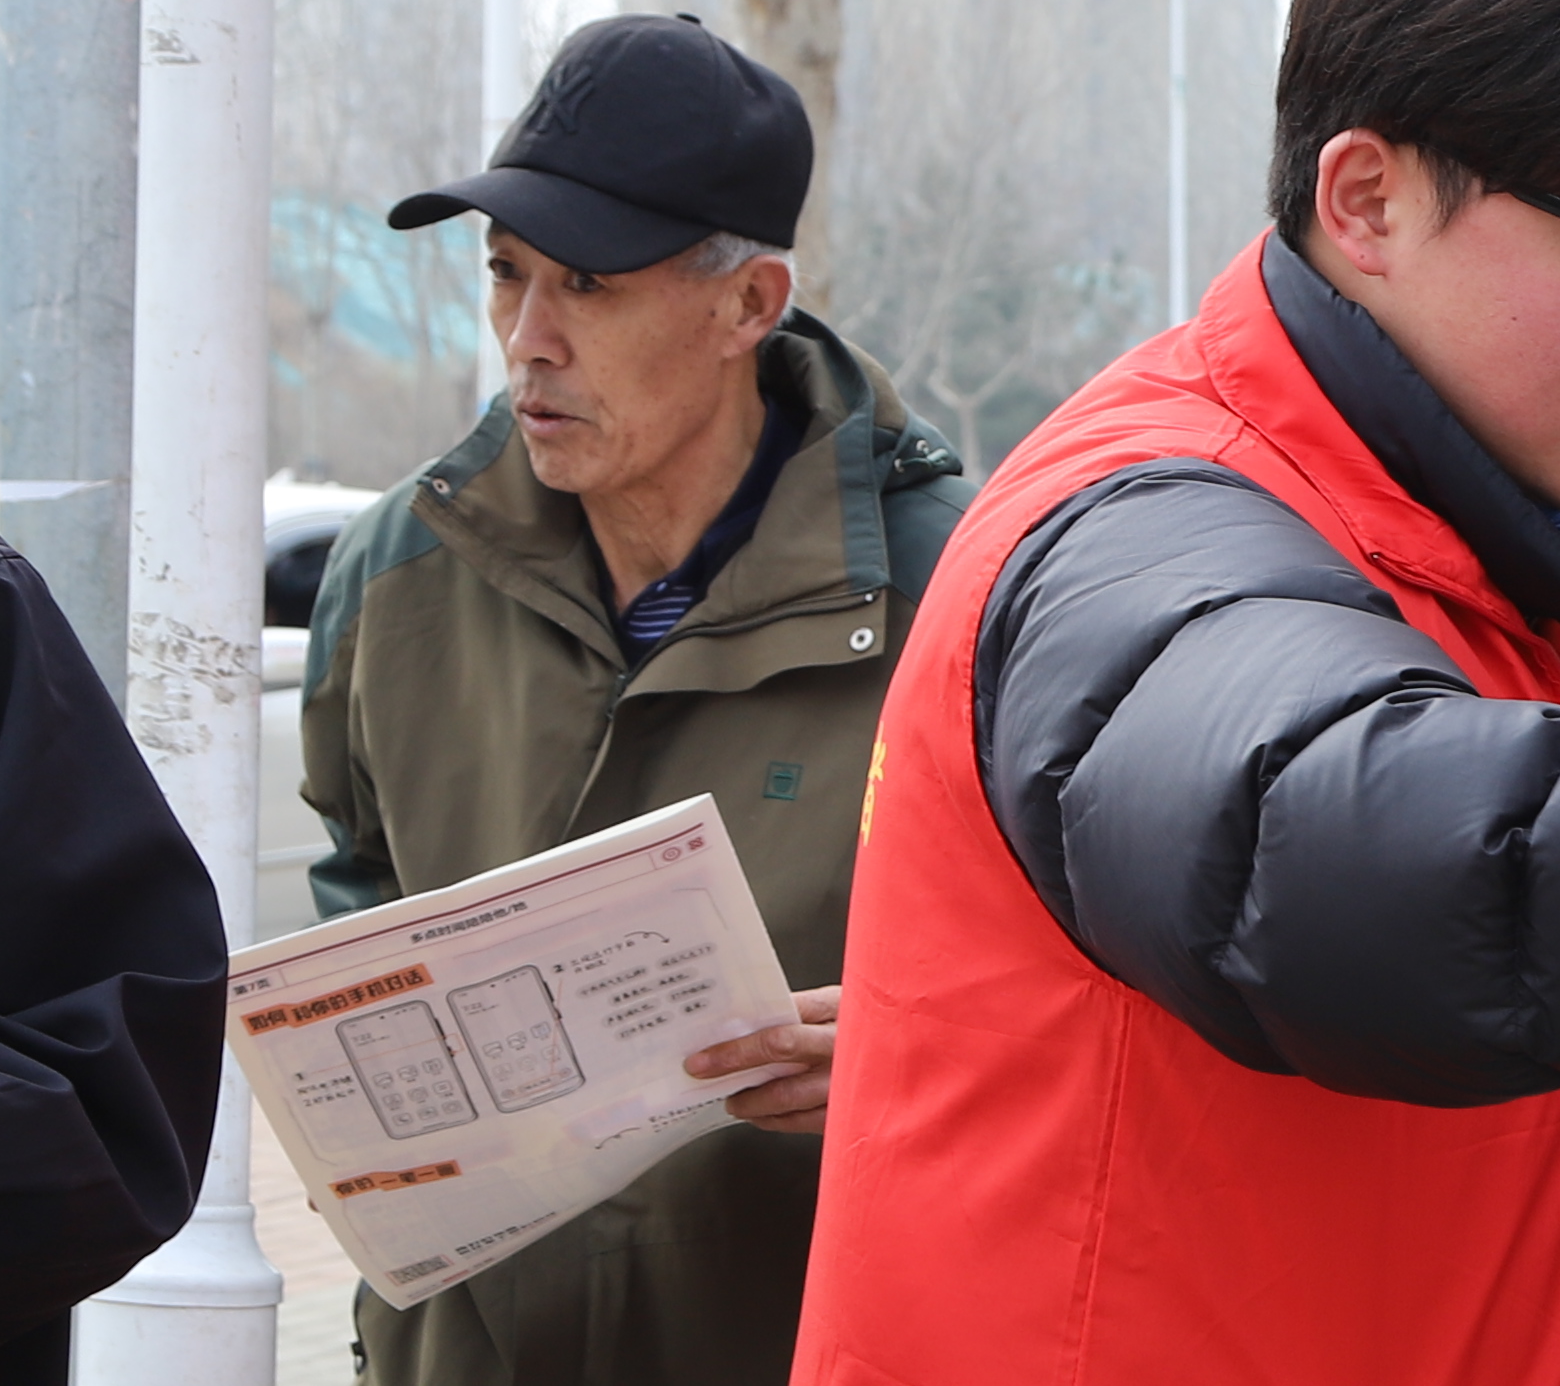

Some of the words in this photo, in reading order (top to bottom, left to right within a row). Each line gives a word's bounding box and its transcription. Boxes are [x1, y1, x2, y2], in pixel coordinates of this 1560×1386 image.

[292, 969, 425, 1021] 和你的手机对话
